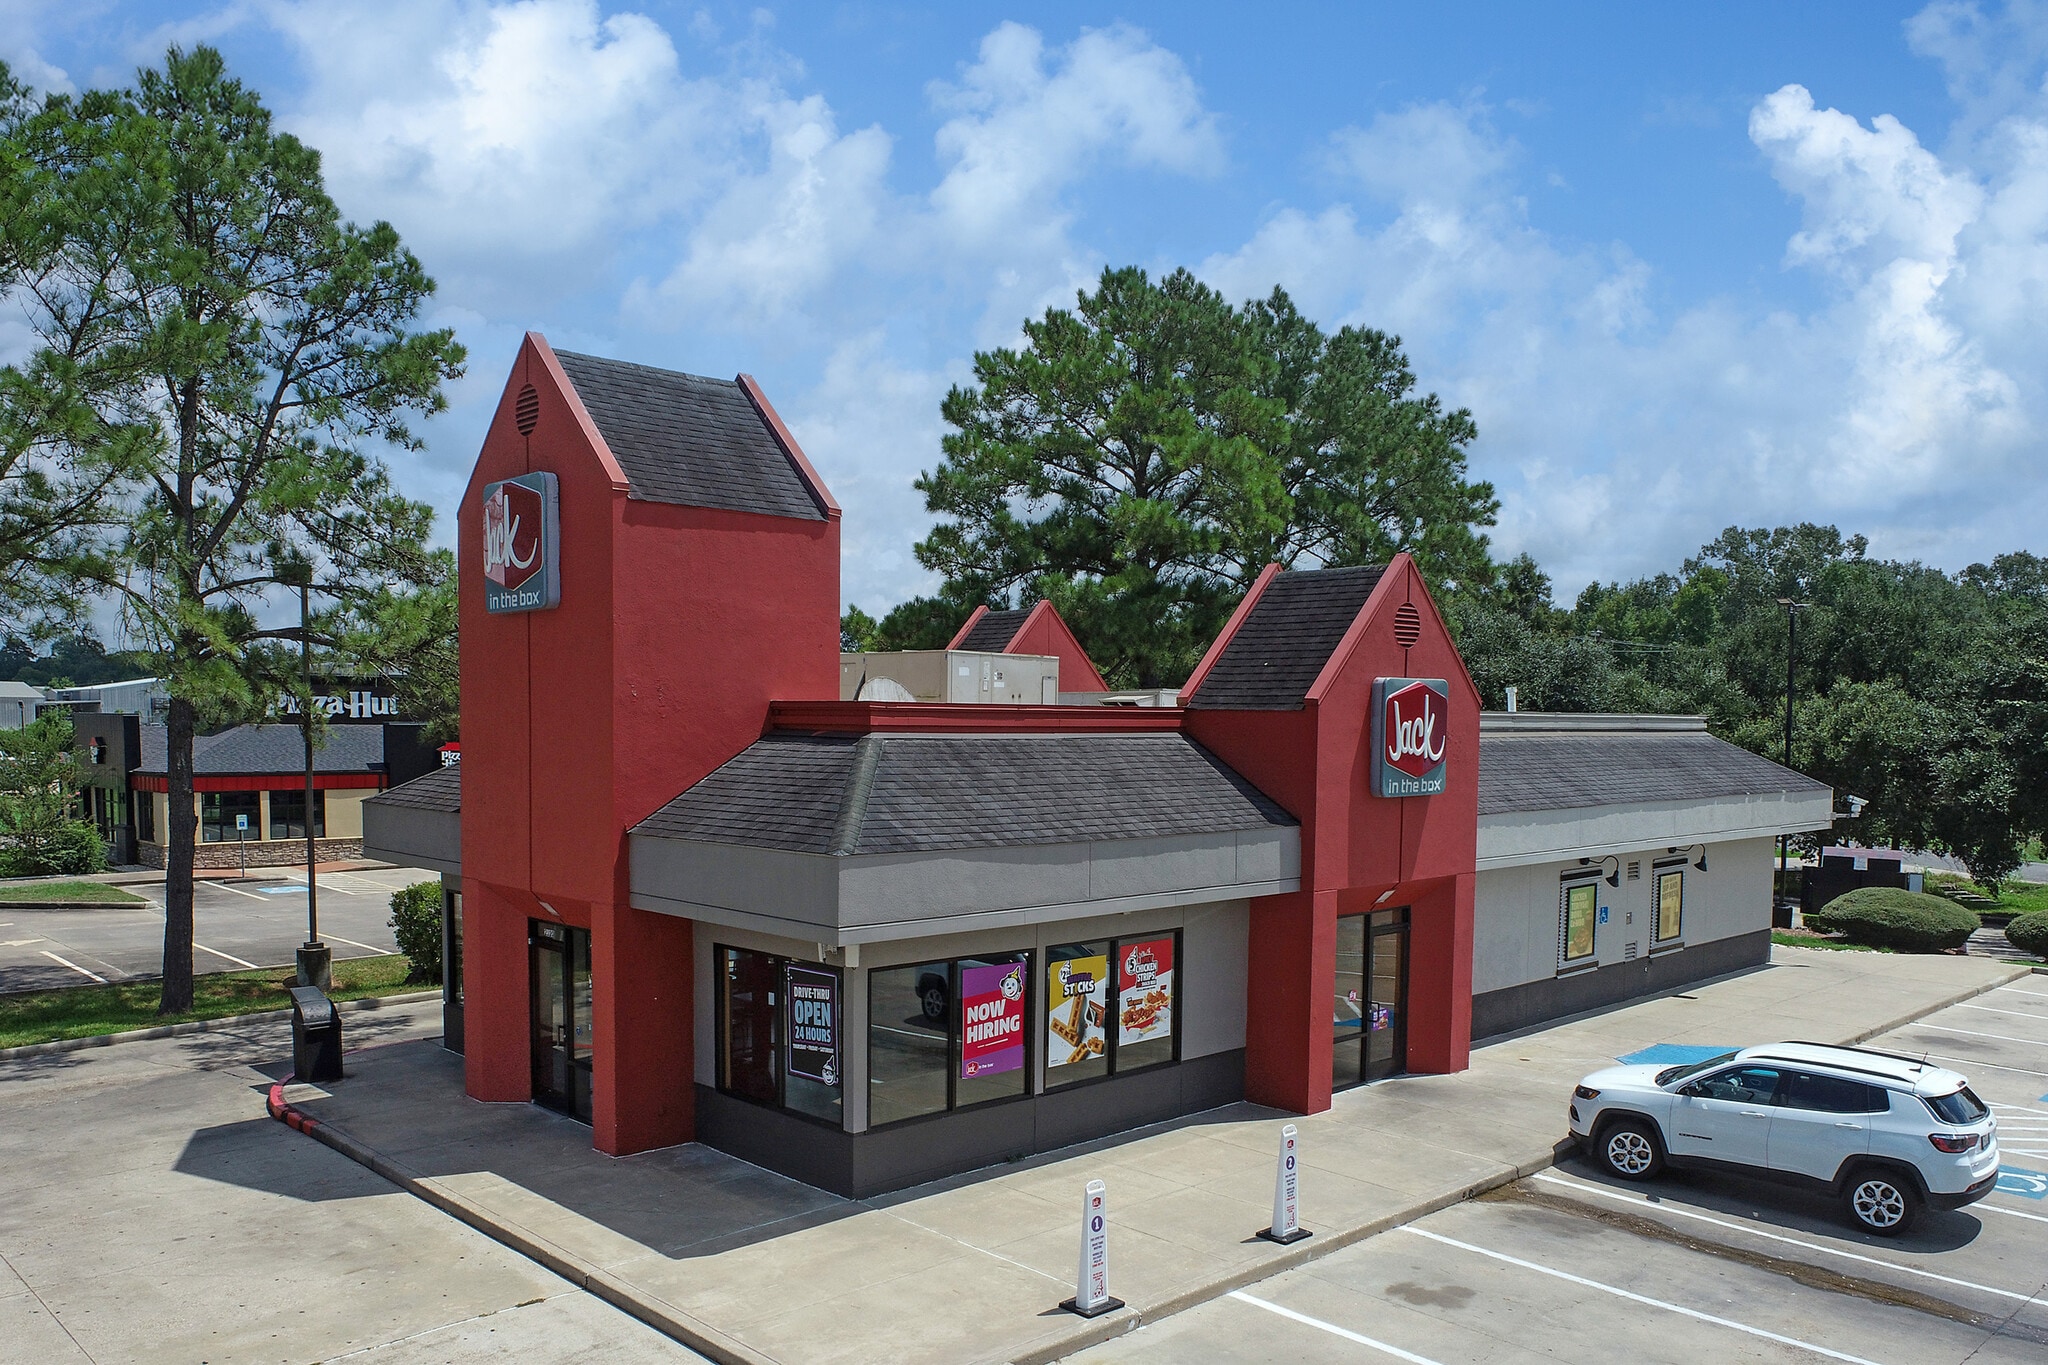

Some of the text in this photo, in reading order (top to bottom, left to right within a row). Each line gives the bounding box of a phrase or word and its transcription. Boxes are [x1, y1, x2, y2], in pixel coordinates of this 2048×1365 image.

[484, 494, 538, 573] Jack
[489, 590, 540, 610] in the box
[265, 690, 399, 718] Piza Hut
[1388, 694, 1446, 761] Jack
[441, 751, 461, 760] Pizz
[1388, 778, 1442, 794] in the box
[1135, 962, 1158, 973] CHICKEN
[1137, 971, 1155, 982] STRIPS
[793, 986, 830, 1000] DRIVE-THRU
[794, 1000, 831, 1027] OPEN
[966, 999, 1006, 1025] NOW
[795, 1026, 832, 1043] 24 HOURS
[966, 1014, 1020, 1045] HIRING
[1288, 1157, 1294, 1169] 2
[1093, 1217, 1100, 1230] 1
